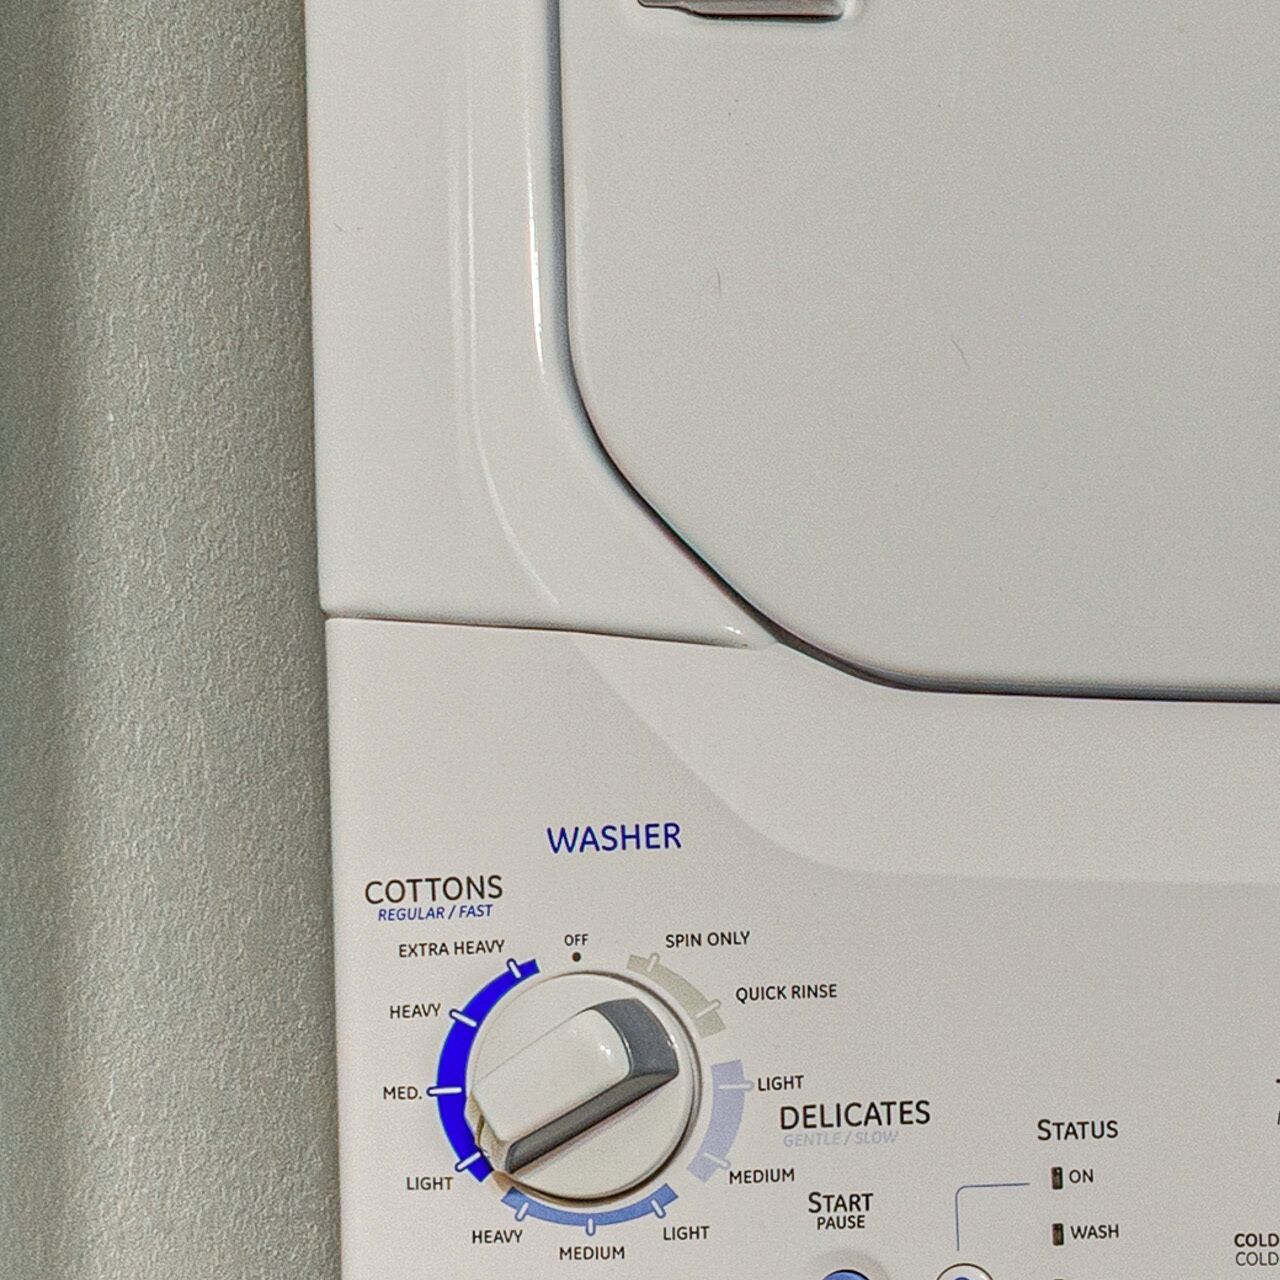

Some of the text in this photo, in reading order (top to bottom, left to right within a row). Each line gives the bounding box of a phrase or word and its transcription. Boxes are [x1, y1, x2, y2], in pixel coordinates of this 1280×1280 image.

[547, 823, 681, 853] WASHER
[365, 875, 503, 904] COTTONS
[378, 906, 445, 921] REGULAR
[459, 904, 493, 917] FAST
[564, 933, 588, 946] OFF
[666, 931, 750, 948] SPIN ONLY
[399, 940, 505, 958] EXTRA HEAVY
[736, 984, 837, 1004] QUICK RINSE
[390, 1003, 441, 1019] HEAVY
[758, 1075, 804, 1092] LIGHT
[383, 1085, 422, 1101] MED.
[780, 1100, 930, 1130] DELICATES
[783, 1132, 841, 1147] GENTLE
[855, 1130, 899, 1145] SLOW
[406, 1176, 453, 1191] LIGHT
[729, 1168, 795, 1184] MEDIUM
[1069, 1169, 1094, 1184] ON
[817, 1215, 865, 1230] PAUSE
[472, 1230, 523, 1244] HEAVY
[663, 1225, 709, 1241] LIGHT
[1070, 1224, 1119, 1239] WASH
[1234, 1233, 1280, 1248] COLD
[559, 1246, 625, 1260] MEDIUM
[1235, 1251, 1279, 1266] COLD
